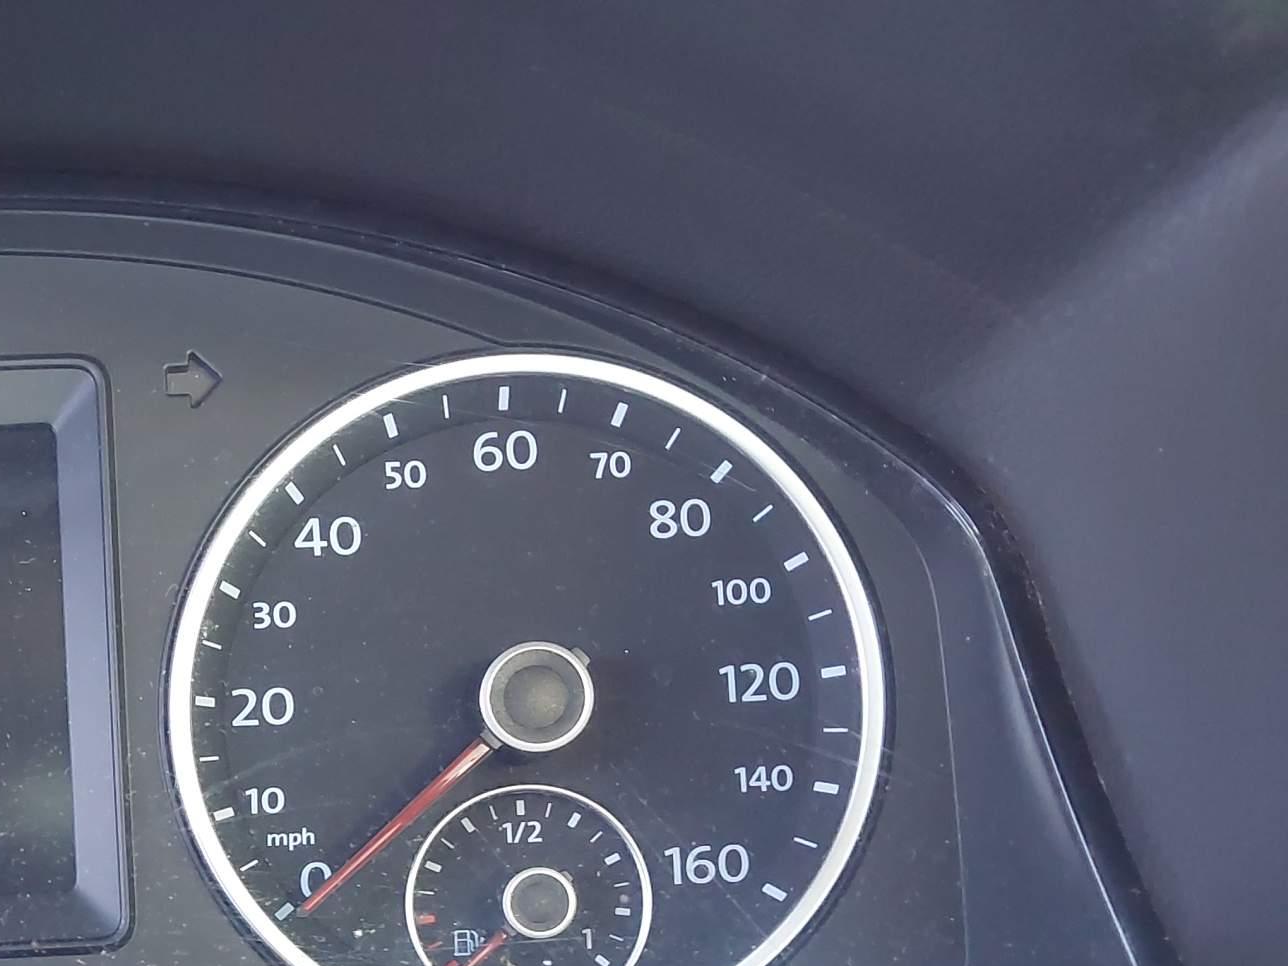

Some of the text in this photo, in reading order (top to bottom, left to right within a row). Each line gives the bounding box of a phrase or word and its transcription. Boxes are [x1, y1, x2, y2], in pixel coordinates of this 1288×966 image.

[473, 430, 538, 472] 60
[589, 452, 631, 479] 70
[384, 460, 427, 490] 50
[649, 498, 711, 538] 80
[294, 516, 362, 557] 40
[711, 577, 771, 606] 100
[252, 601, 297, 629] 30
[718, 661, 800, 703] 120
[231, 687, 295, 727] 20
[734, 764, 793, 793] 140
[245, 787, 285, 815] 10
[267, 828, 315, 850] mph
[502, 820, 543, 844] 1/2
[664, 844, 750, 884] 160
[581, 928, 593, 950] 1
